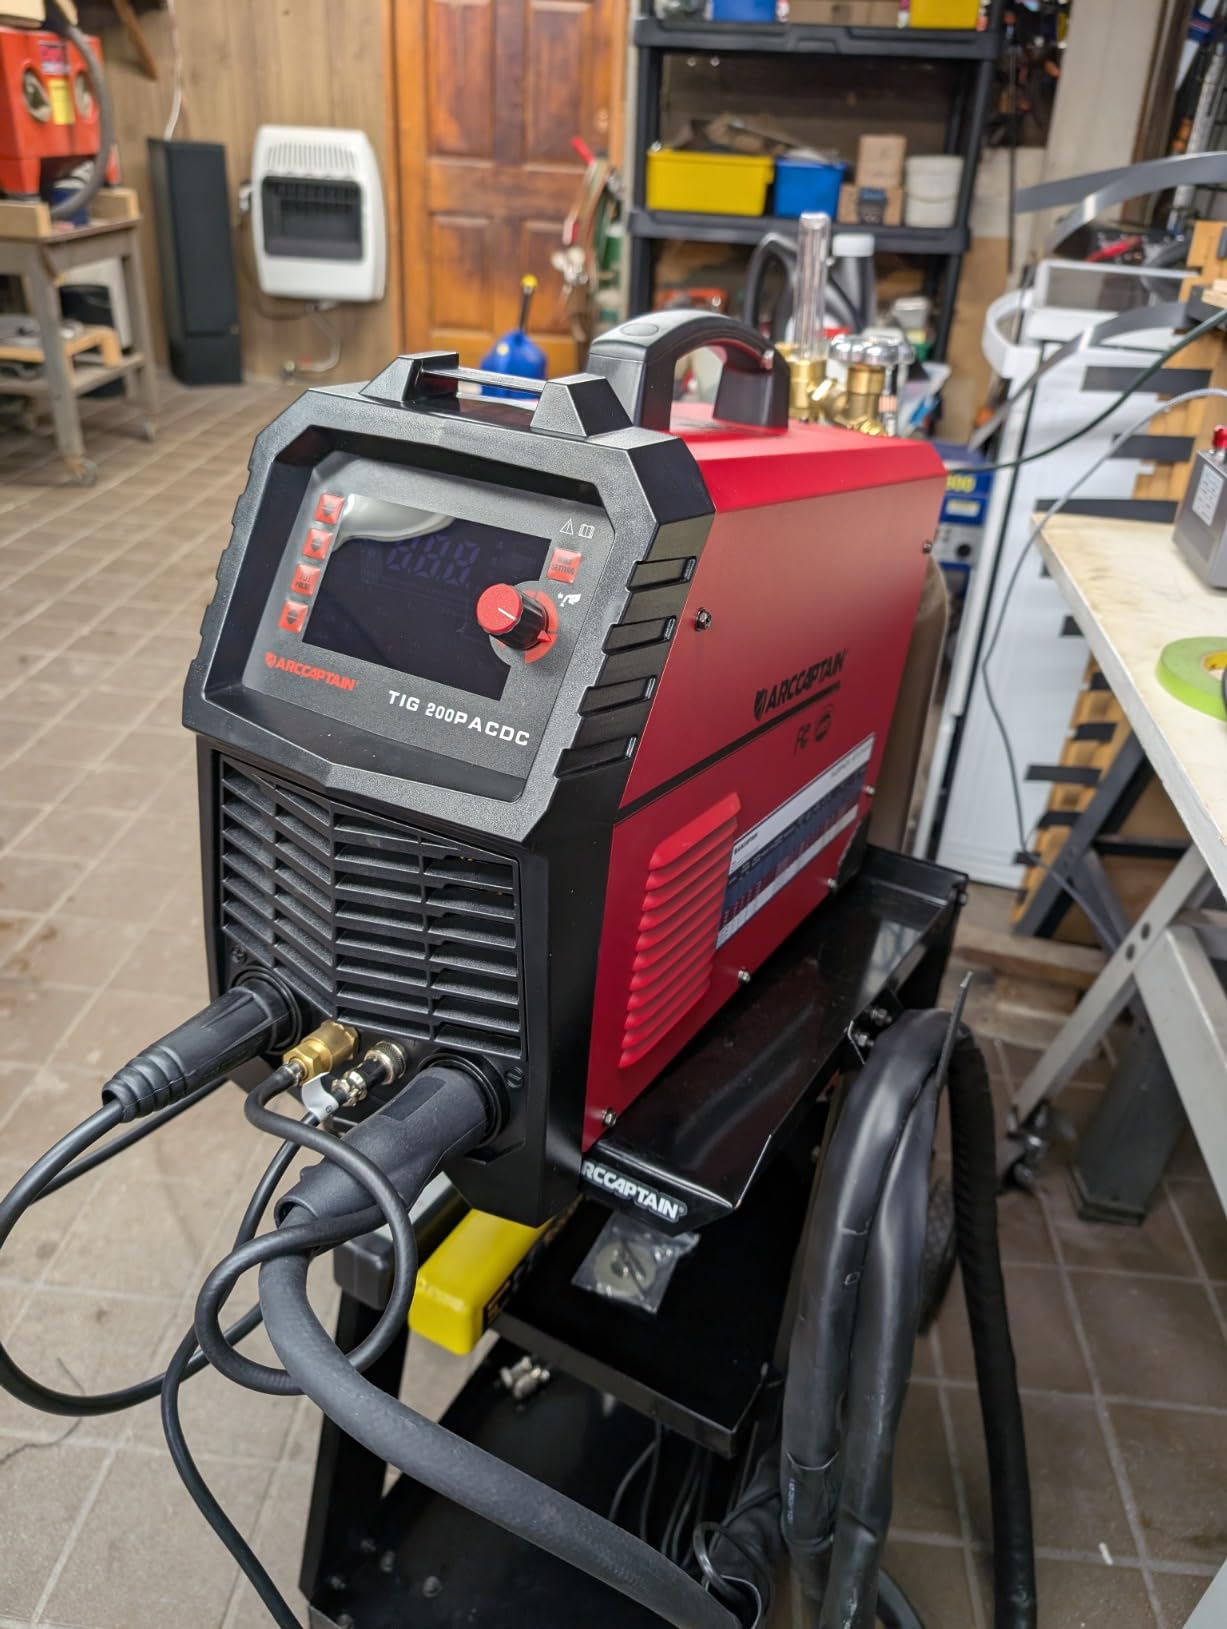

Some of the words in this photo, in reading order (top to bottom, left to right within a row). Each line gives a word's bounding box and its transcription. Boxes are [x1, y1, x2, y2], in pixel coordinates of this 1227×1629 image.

[276, 658, 356, 692] ARCCAPTAIN
[765, 649, 847, 713] ARCCAPTAIN
[388, 690, 420, 712] TIG
[582, 1160, 680, 1220] RCCAPTAIN
